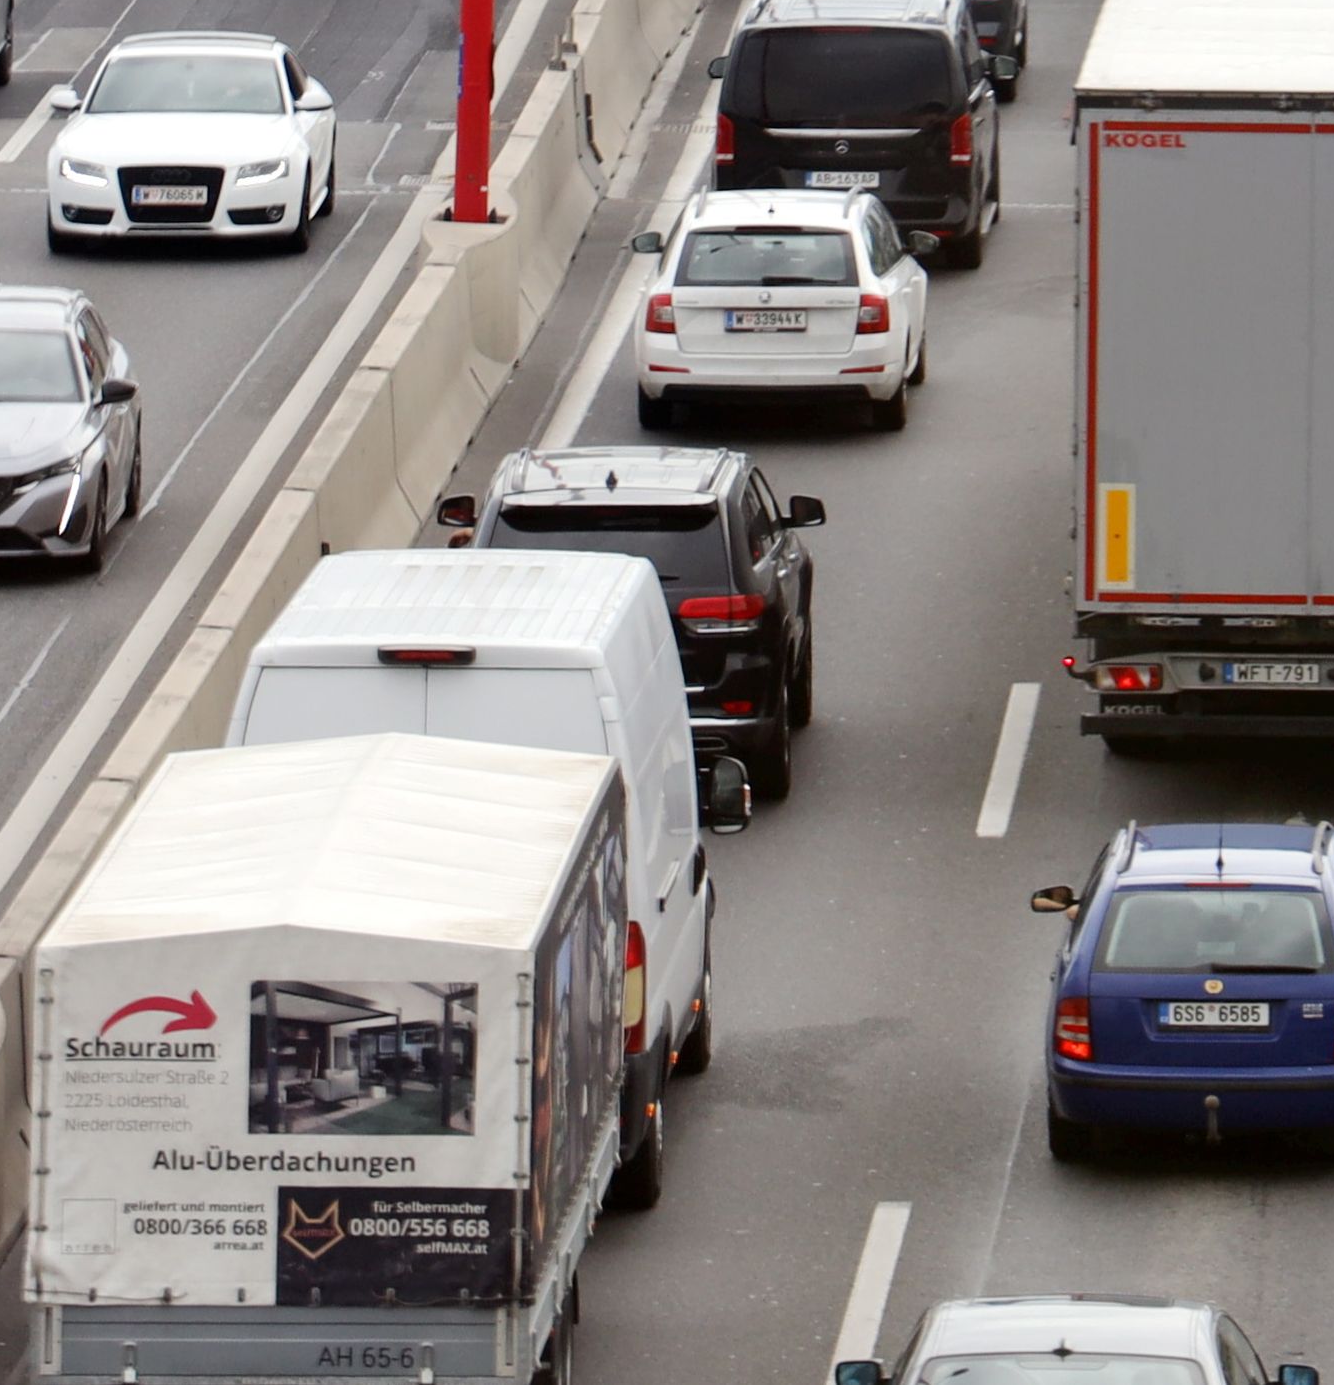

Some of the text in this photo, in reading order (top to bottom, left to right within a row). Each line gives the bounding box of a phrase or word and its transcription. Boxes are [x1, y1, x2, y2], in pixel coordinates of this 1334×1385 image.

[1237, 665, 1314, 681] WFT-791
[1173, 1005, 1262, 1023] 6S6 6585
[166, 1070, 216, 1085] Straße
[219, 1070, 230, 1086] 2
[64, 1092, 104, 1108] 2225
[152, 1144, 417, 1180] Alu-Überdachungen
[123, 1200, 265, 1215] geliefert und montiert
[373, 1200, 488, 1214] für Selbermacher
[133, 1217, 268, 1237] 0800/366 668
[349, 1217, 491, 1238] 0800/556 668
[416, 1241, 488, 1255] selfMAX.at
[318, 1346, 415, 1368] AH 65-6
